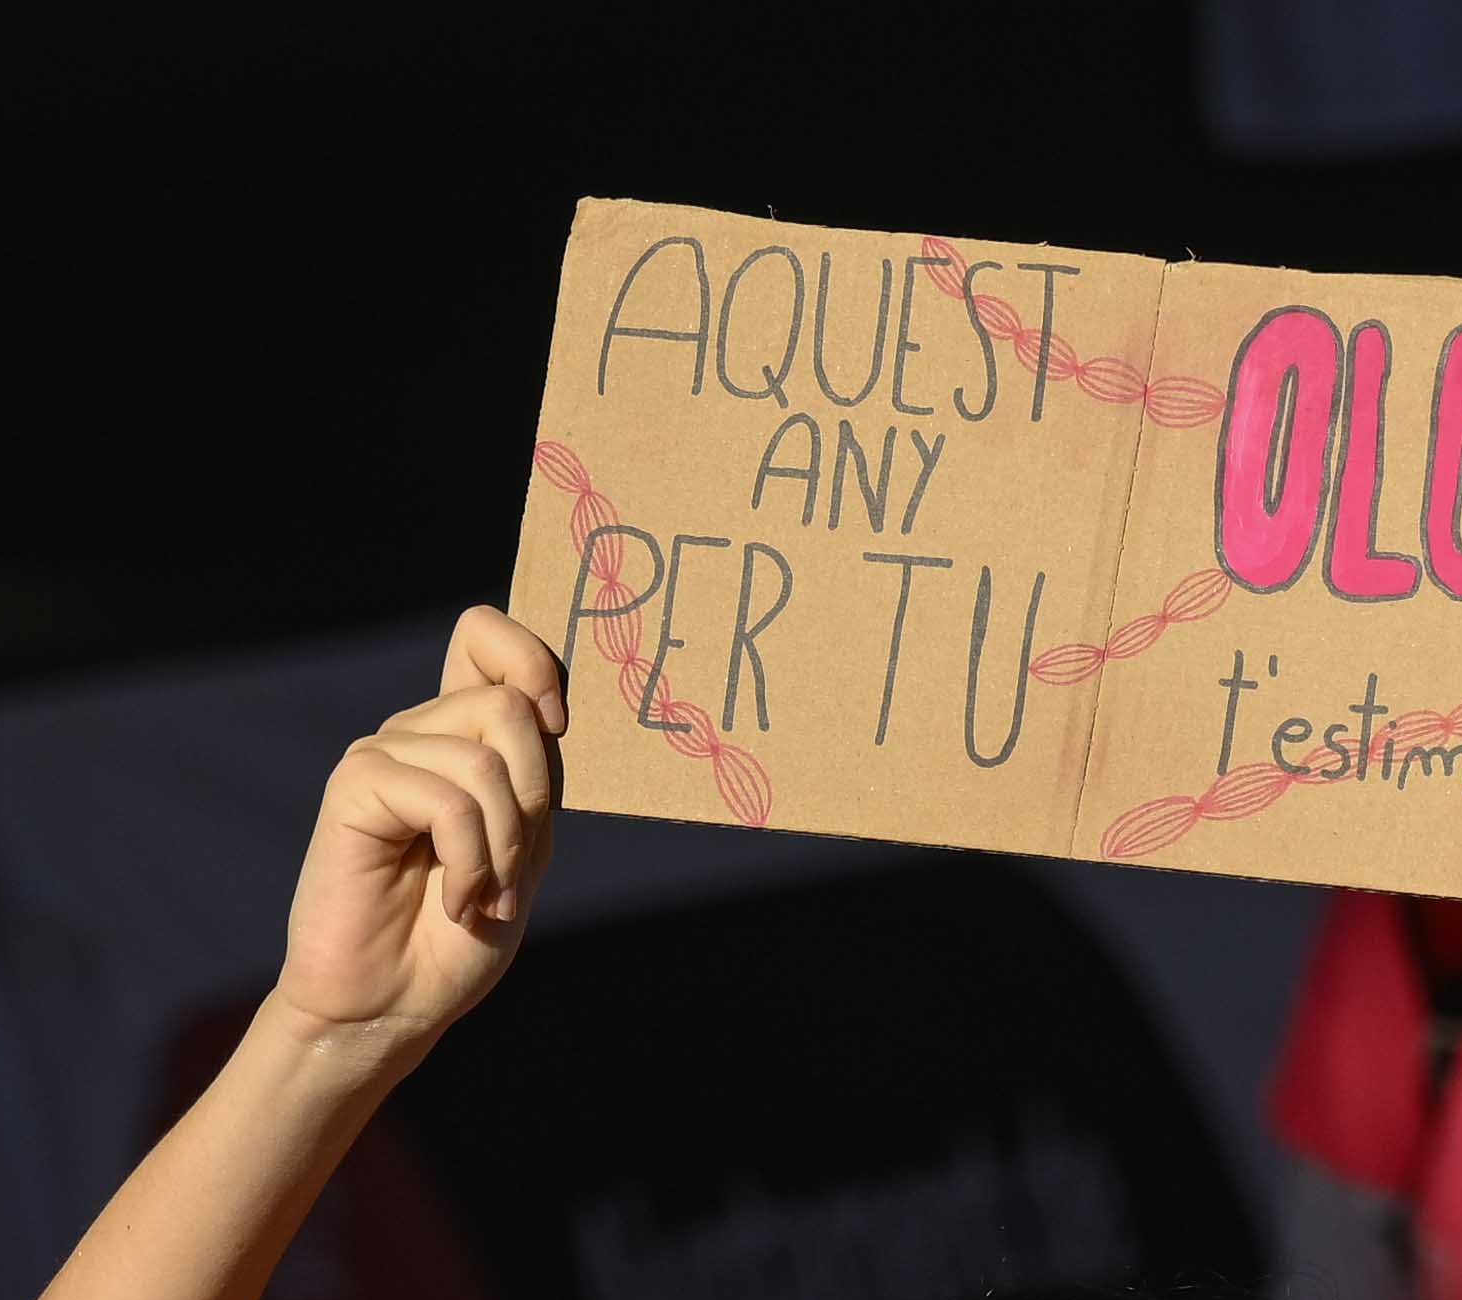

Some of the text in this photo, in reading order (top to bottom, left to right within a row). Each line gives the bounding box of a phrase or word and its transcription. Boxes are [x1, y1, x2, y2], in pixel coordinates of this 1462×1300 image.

[597, 236, 1082, 424] AQUEST
[750, 411, 948, 535] ANY
[562, 524, 1048, 769] PER TU
